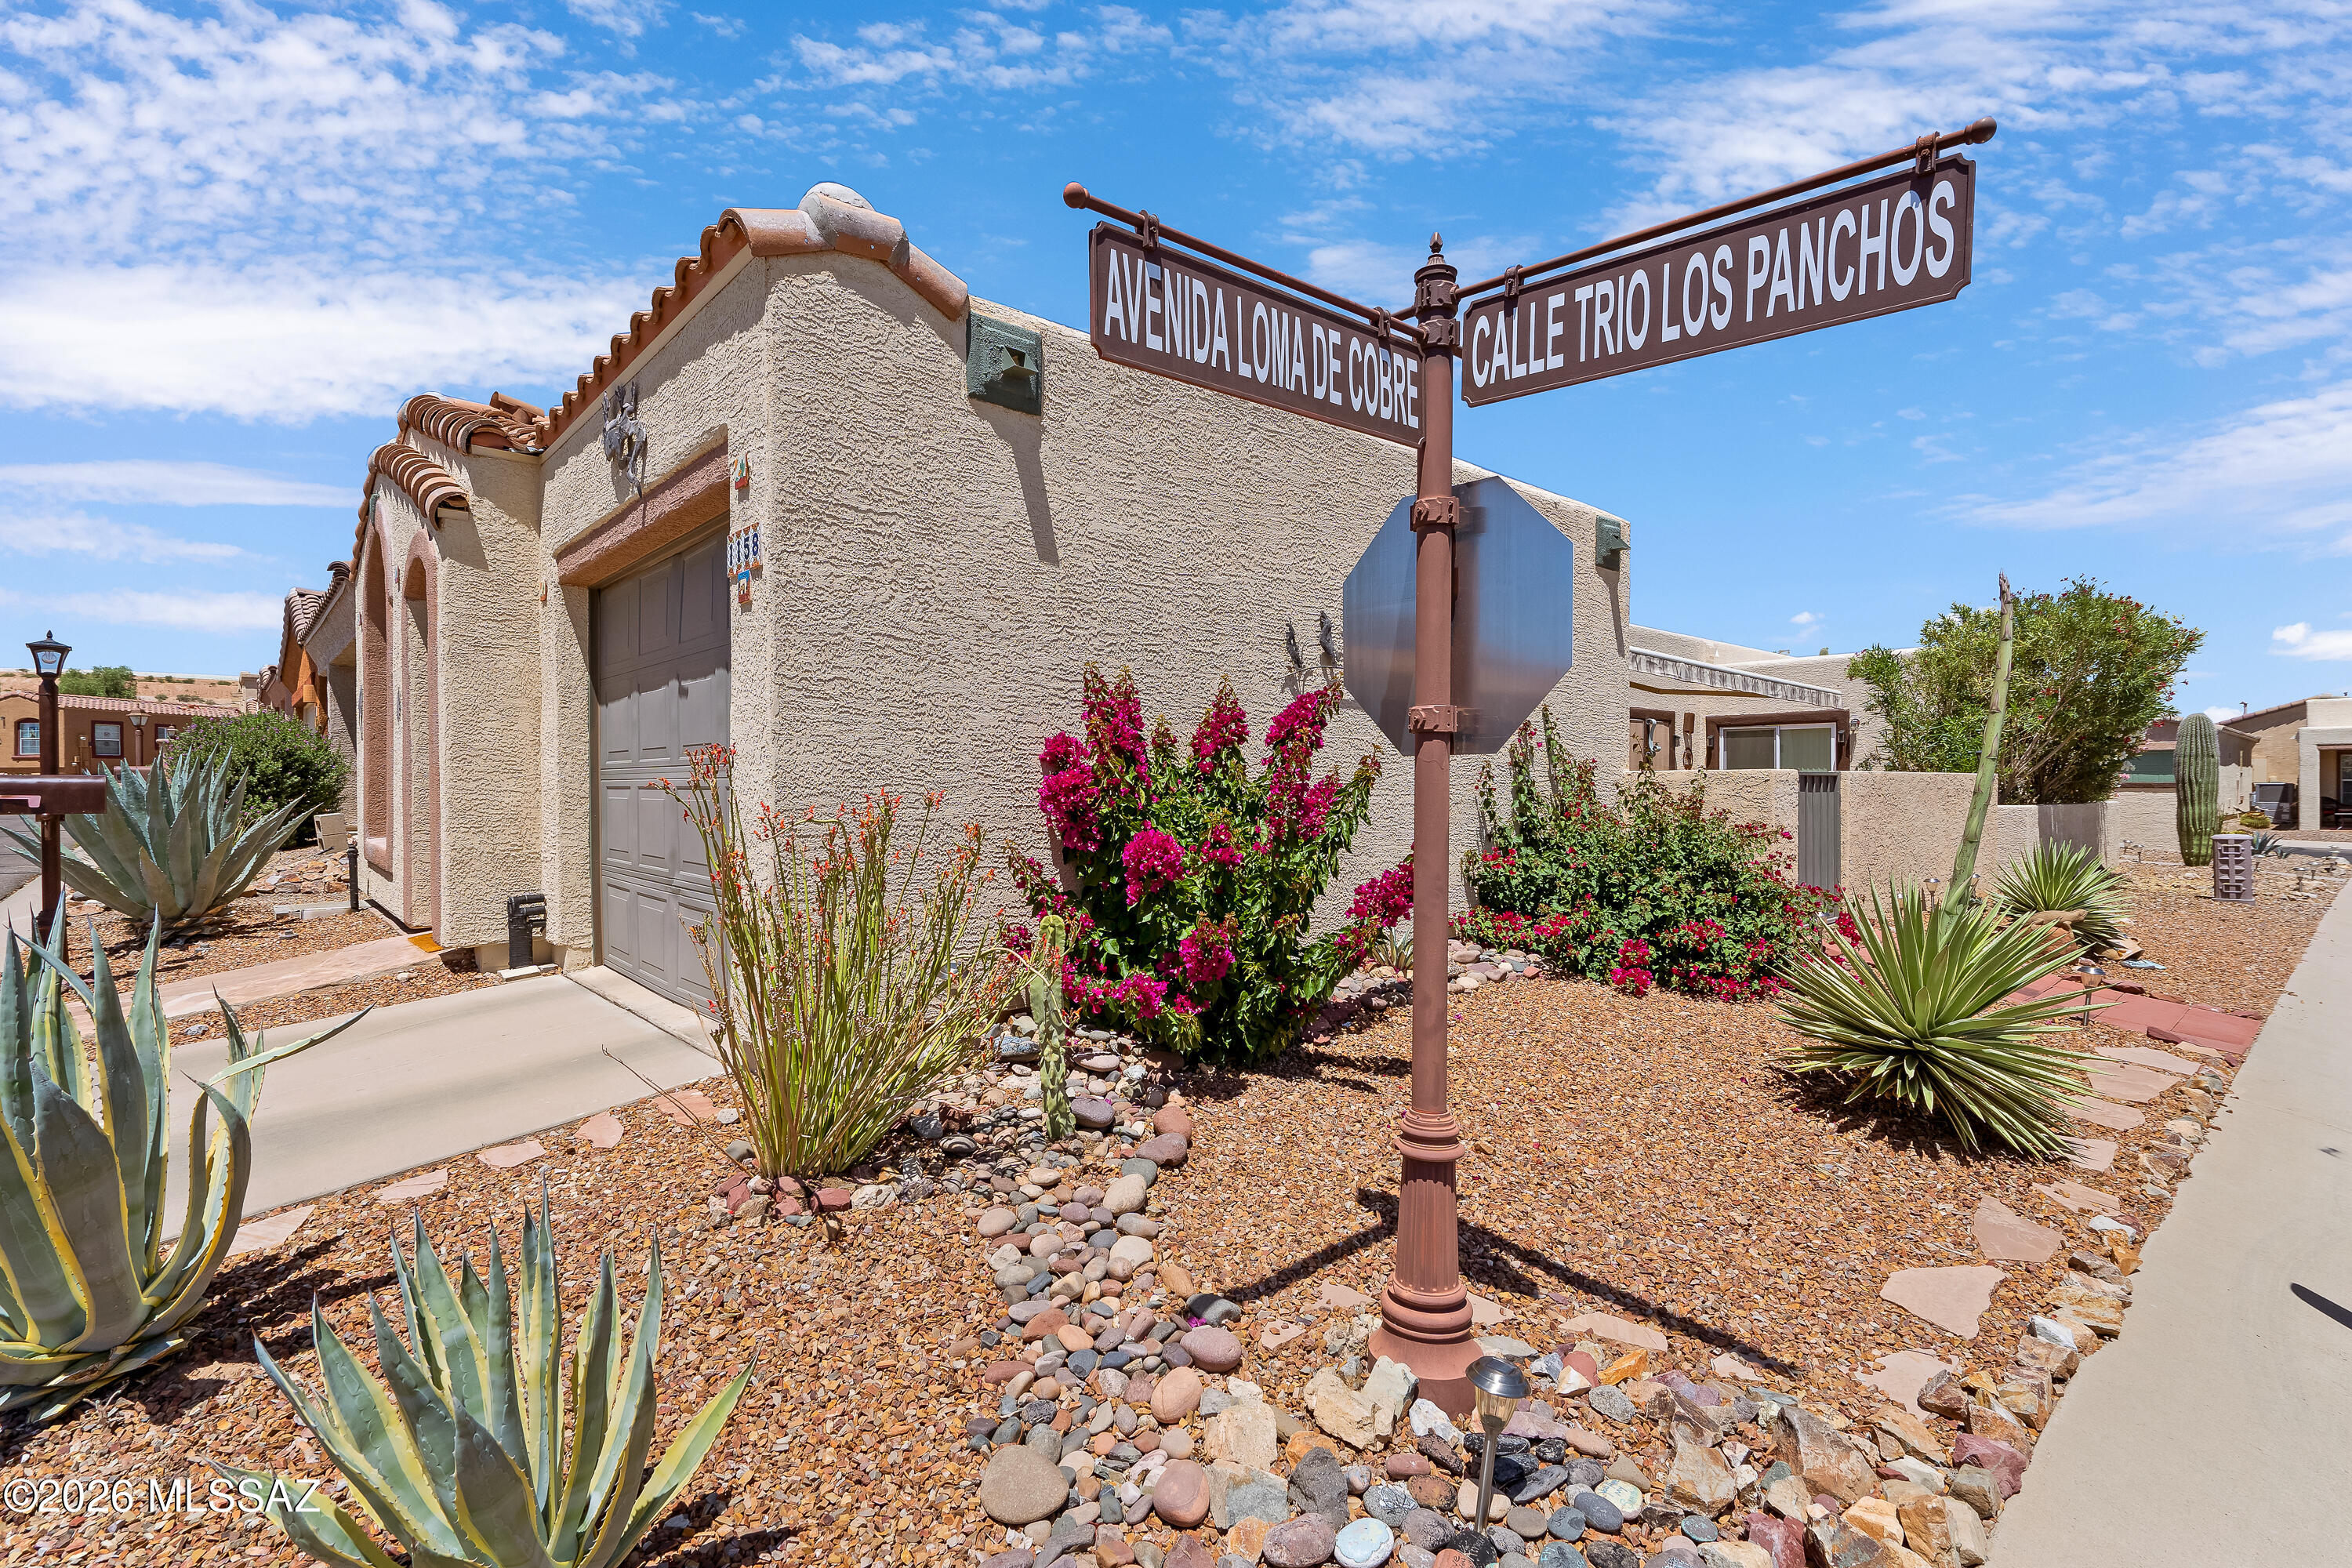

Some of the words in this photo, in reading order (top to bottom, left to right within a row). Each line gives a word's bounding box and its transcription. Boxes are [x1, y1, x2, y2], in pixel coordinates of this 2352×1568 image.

[1104, 248, 1231, 372] AVENIDA
[1237, 296, 1308, 395] LOMA
[1312, 322, 1343, 406] DE
[1348, 336, 1419, 429] COBRE
[1472, 292, 1565, 388] CALLE
[1575, 268, 1650, 362] TRIO
[1661, 245, 1733, 342] LOS
[1746, 180, 1956, 322] PANCHOS
[729, 532, 759, 567] 1158
